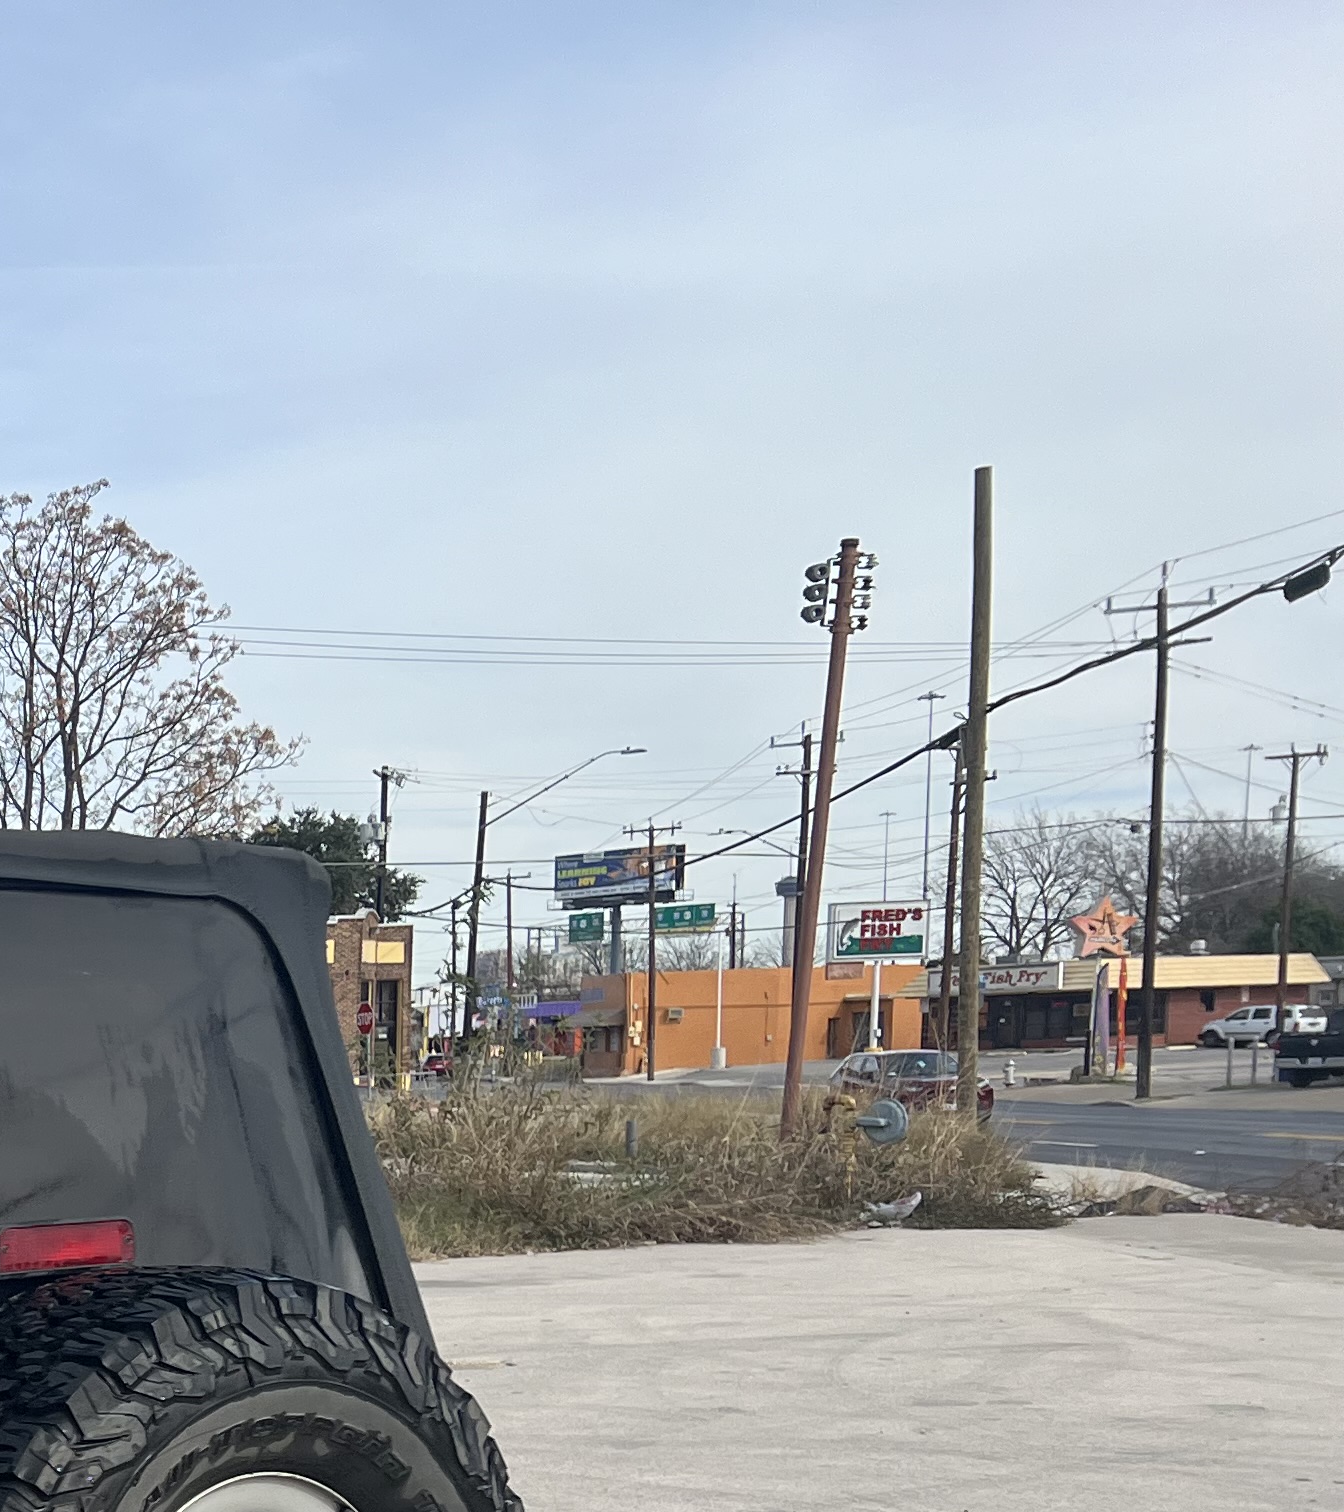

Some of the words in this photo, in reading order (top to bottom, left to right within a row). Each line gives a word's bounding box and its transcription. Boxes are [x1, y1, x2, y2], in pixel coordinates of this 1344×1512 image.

[557, 865, 608, 879] LEARNING
[860, 907, 923, 922] FRED'S
[860, 923, 902, 937] FISH
[859, 937, 895, 952] FRY
[1016, 970, 1048, 986] Fry
[357, 1012, 373, 1026] STOP
